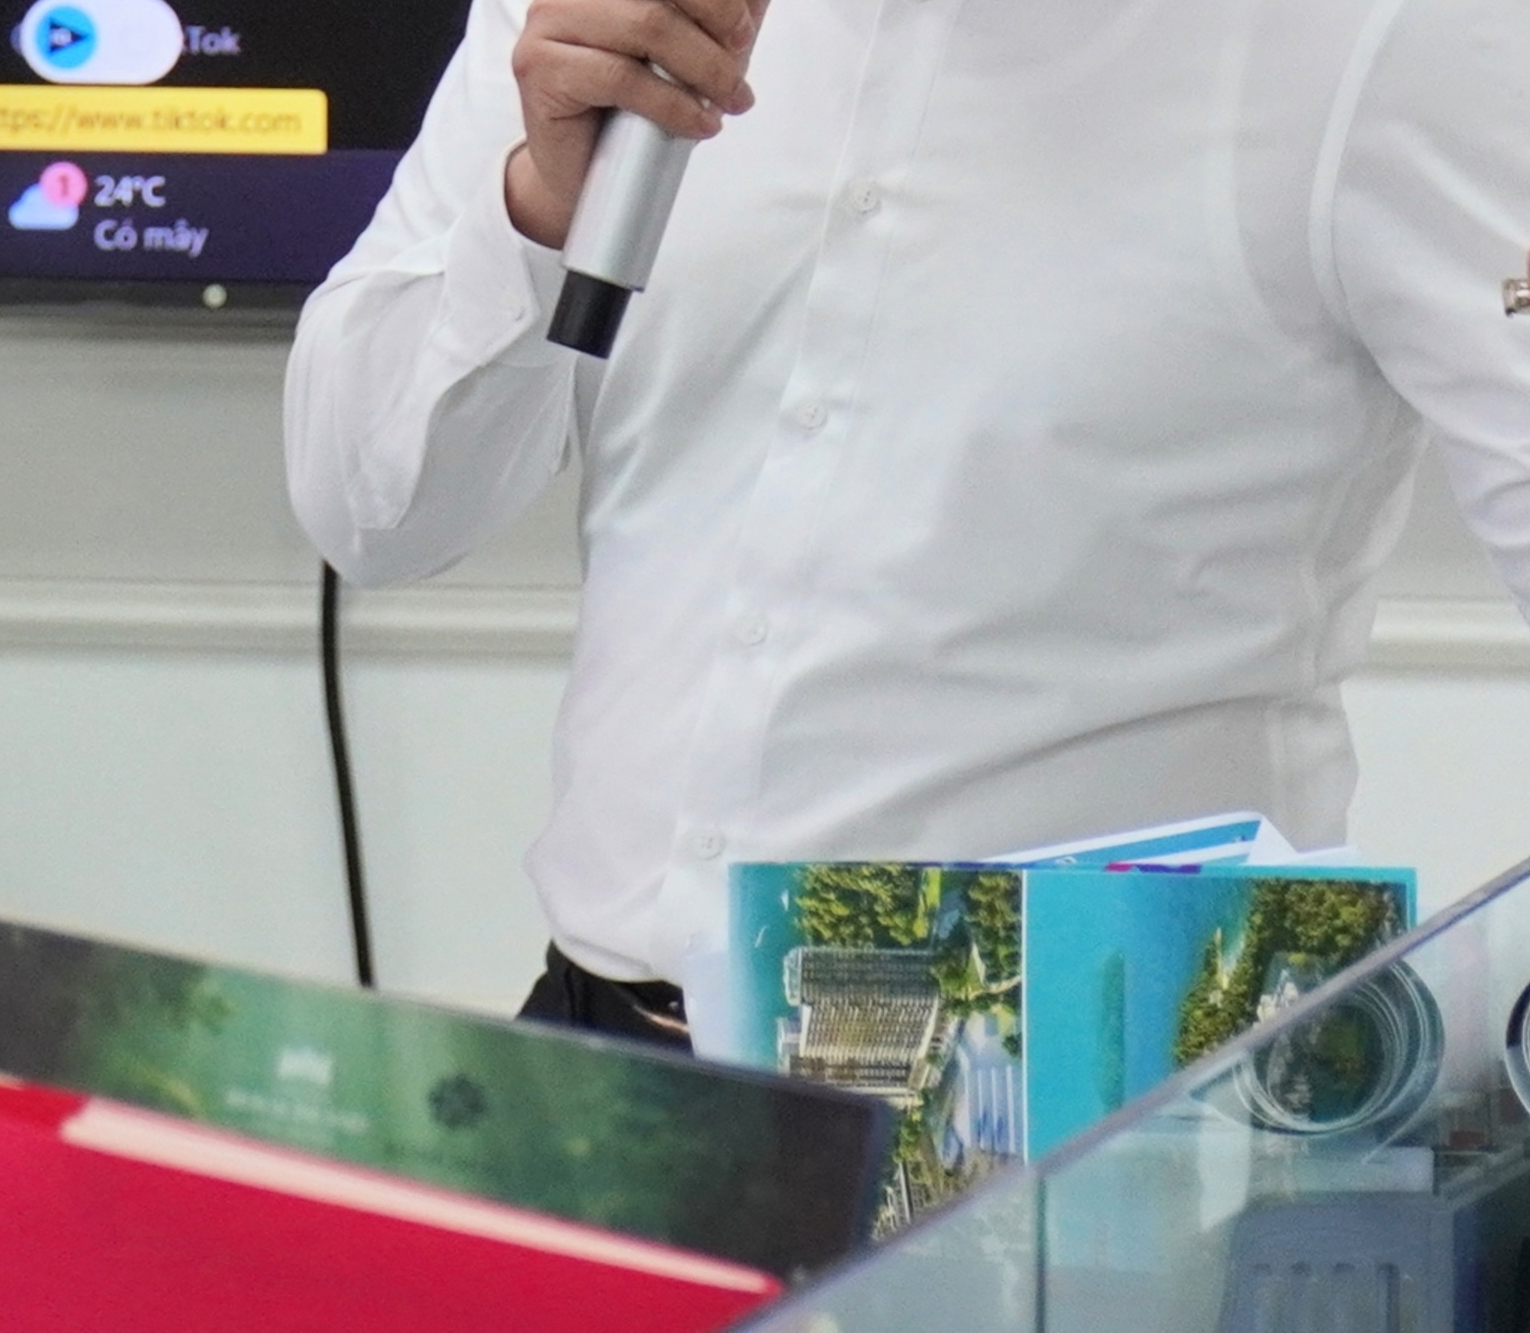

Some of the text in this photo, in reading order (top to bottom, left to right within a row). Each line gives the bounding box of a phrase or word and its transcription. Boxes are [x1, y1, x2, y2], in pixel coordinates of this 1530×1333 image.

[93, 174, 167, 208] 24°C
[93, 218, 210, 259] Có mây
